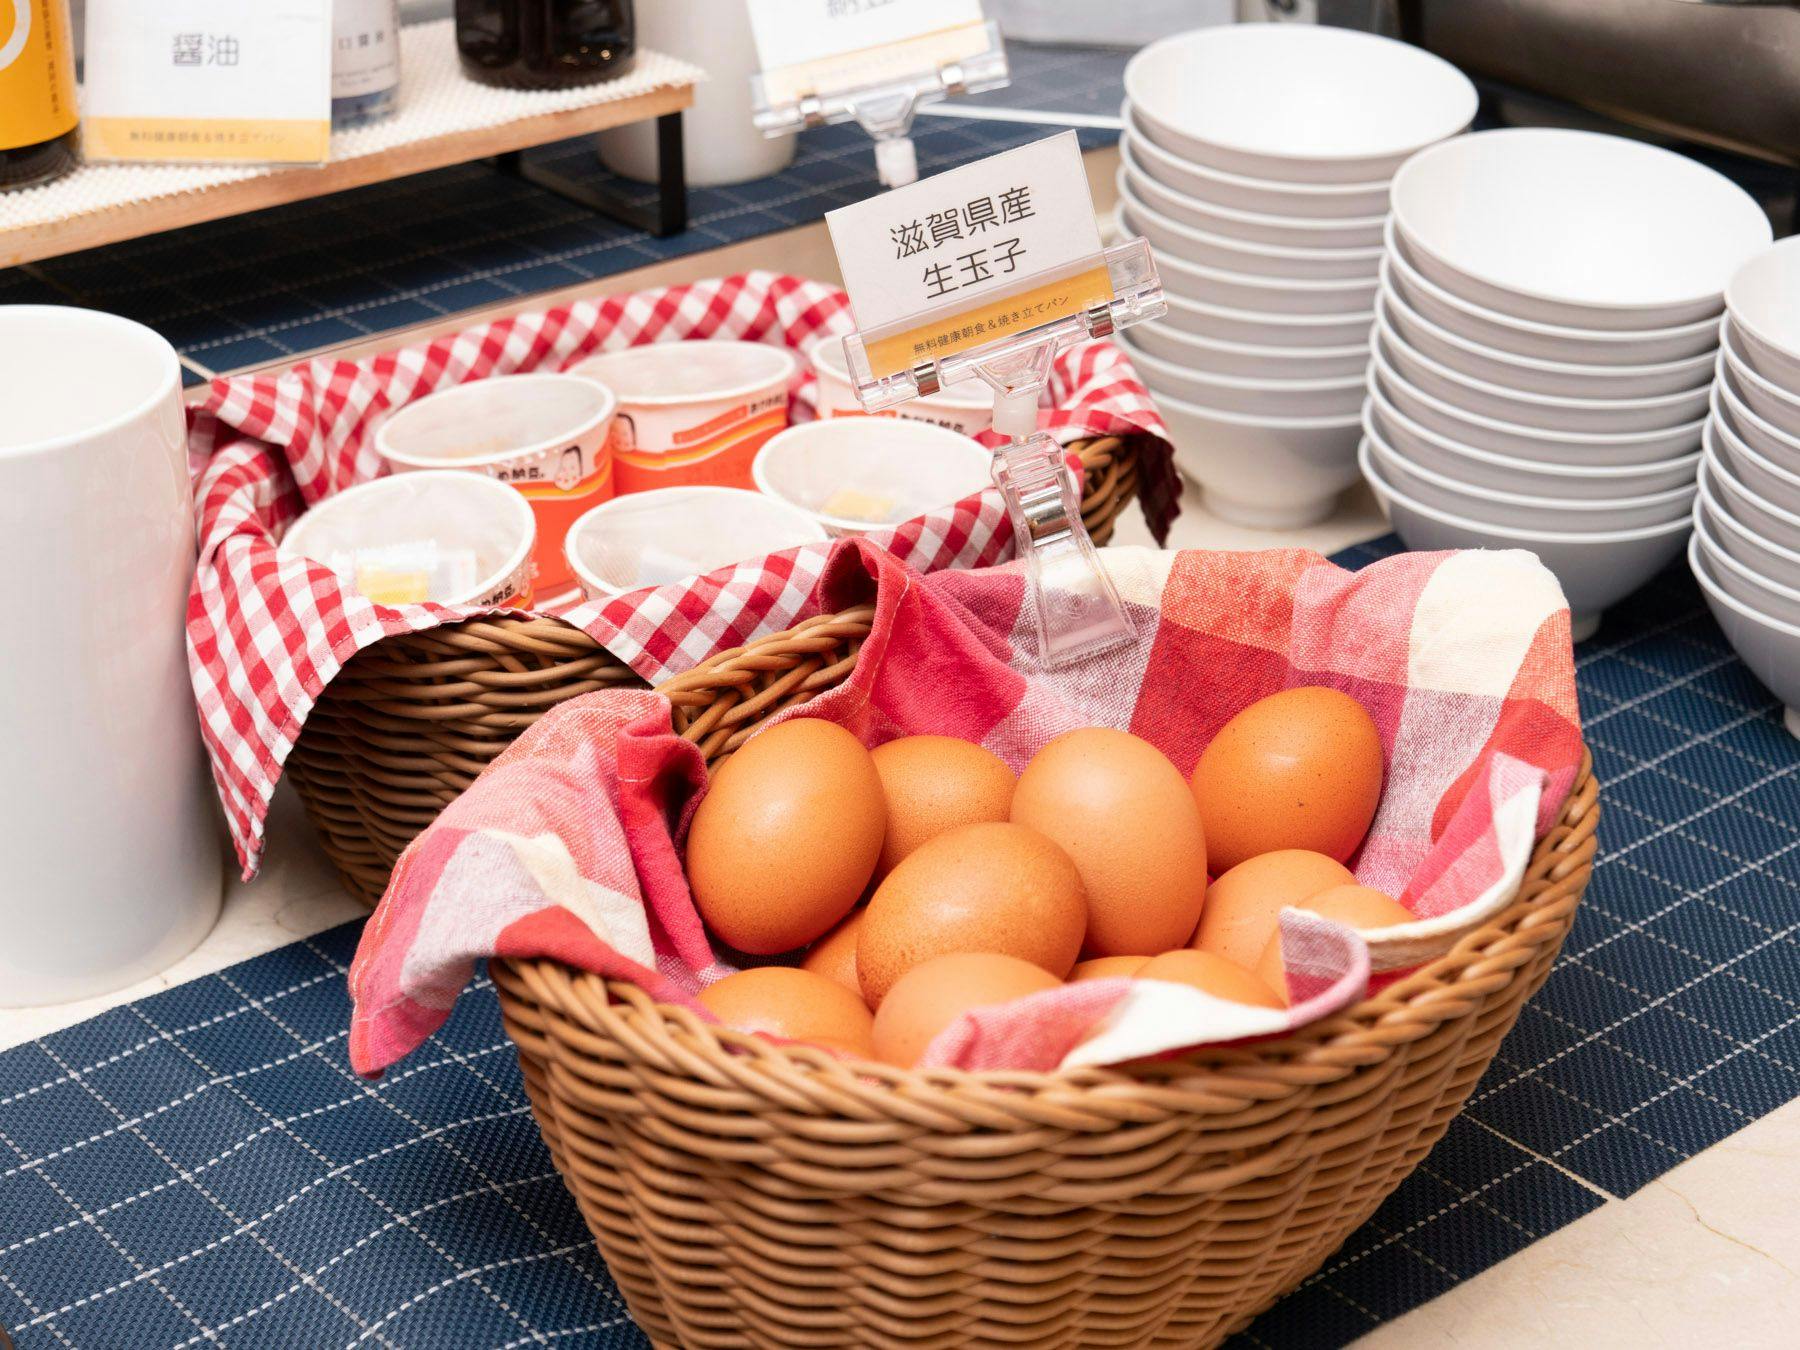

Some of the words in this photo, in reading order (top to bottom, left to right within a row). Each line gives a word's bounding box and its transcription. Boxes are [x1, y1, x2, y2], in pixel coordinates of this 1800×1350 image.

[173, 33, 239, 66] 醤油
[889, 185, 1036, 260] 滋賀県産
[921, 237, 1027, 299] 生玉子
[912, 296, 1069, 353] 無料健康朝食&焼き立てパン
